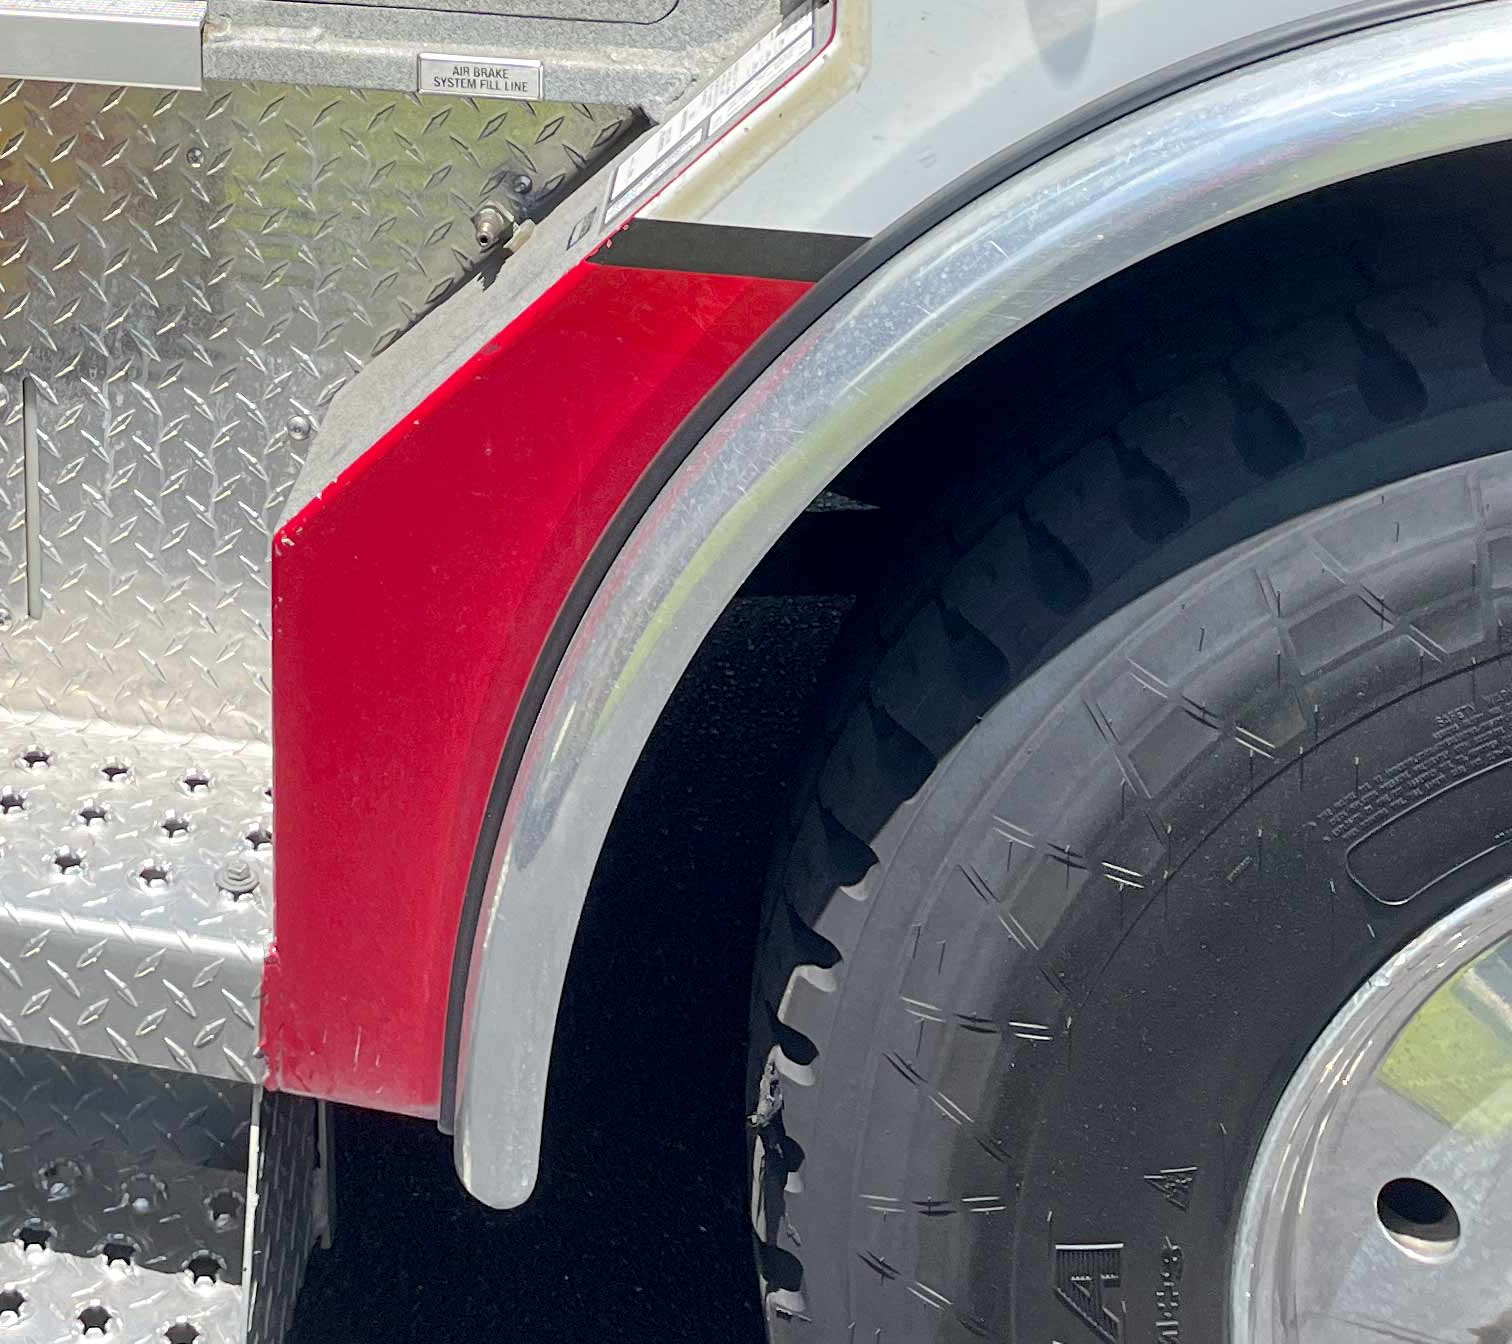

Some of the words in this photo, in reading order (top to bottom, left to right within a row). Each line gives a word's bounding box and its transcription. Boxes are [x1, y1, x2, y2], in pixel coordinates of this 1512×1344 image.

[452, 66, 470, 76] AIR
[473, 67, 509, 78] BRAKE
[433, 76, 477, 89] SYSTEM
[480, 79, 502, 91] FILL
[504, 81, 529, 92] LINE
